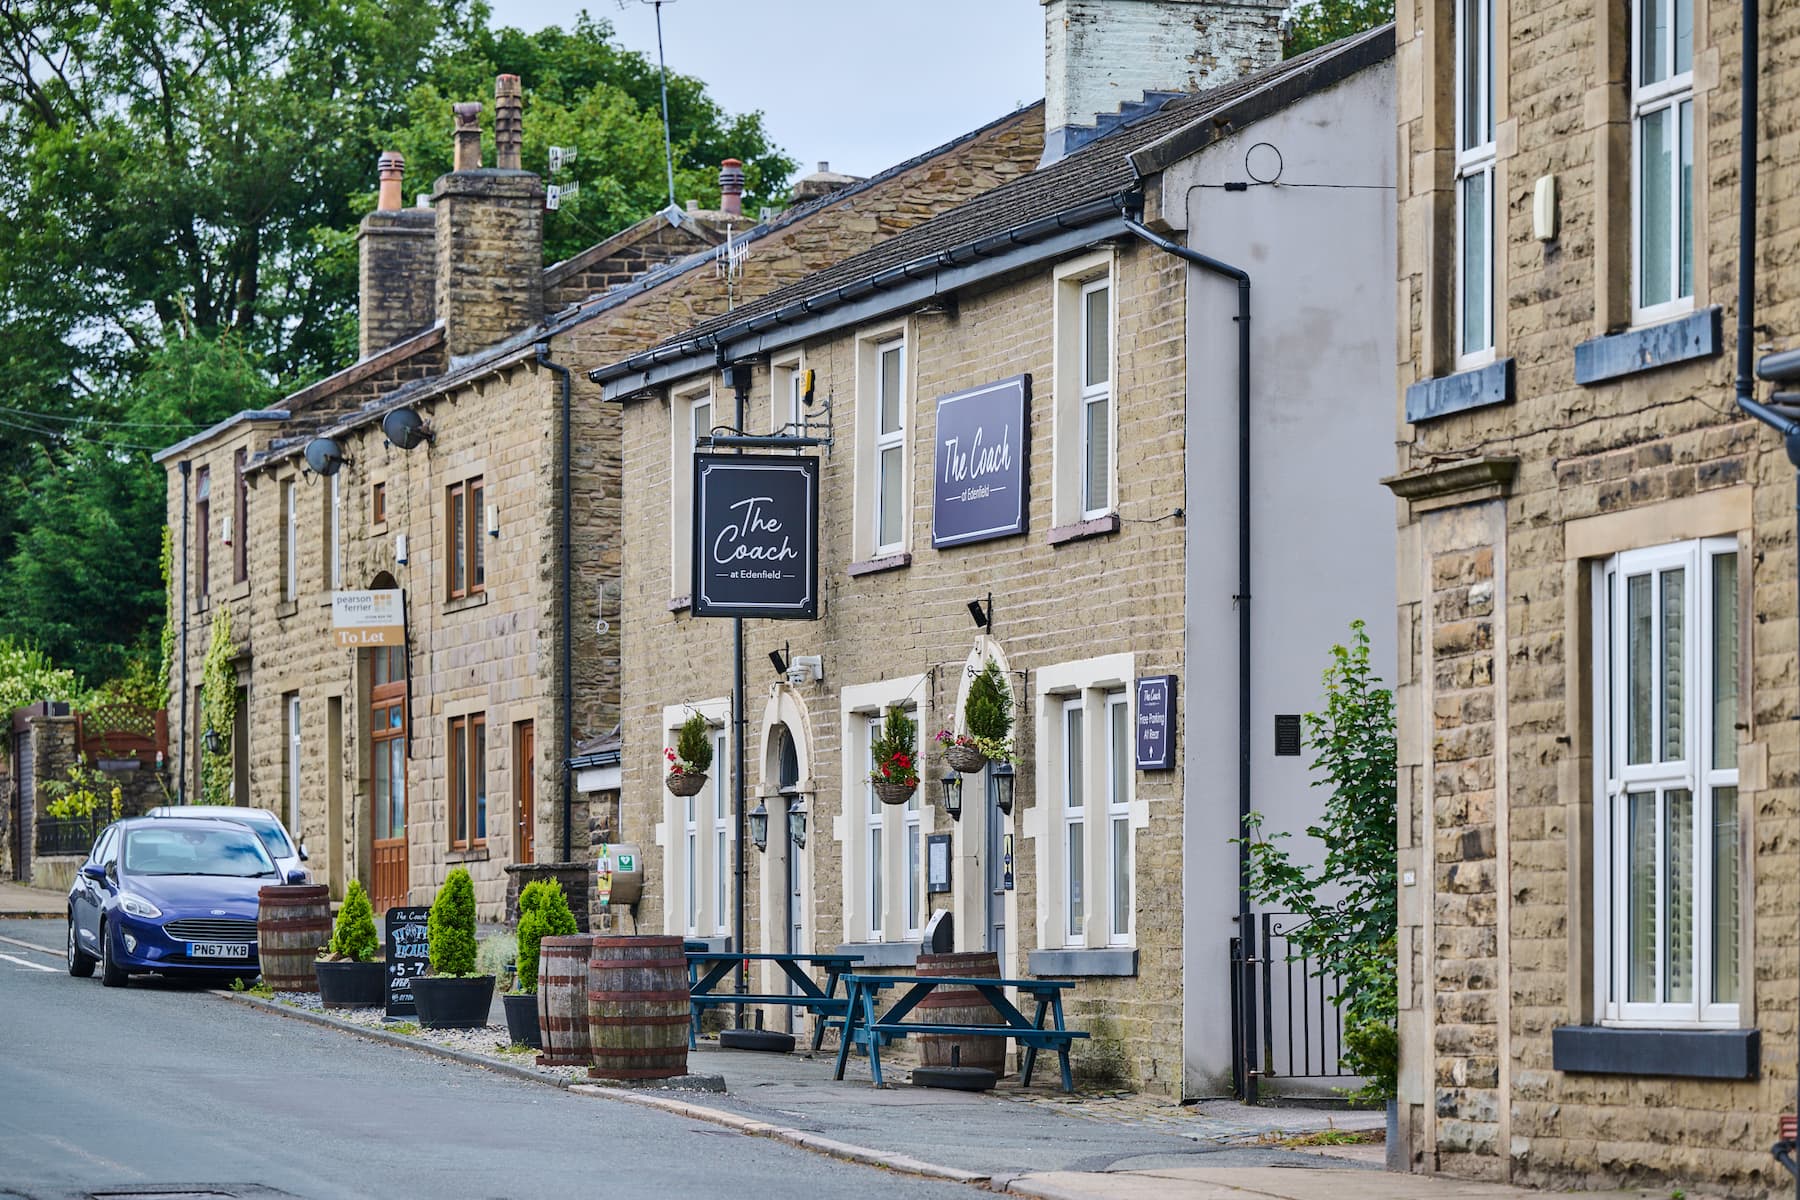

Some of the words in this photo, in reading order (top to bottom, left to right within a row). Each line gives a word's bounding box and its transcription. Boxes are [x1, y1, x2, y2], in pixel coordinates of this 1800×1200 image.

[945, 436, 967, 484] The
[970, 423, 1011, 479] Coach
[967, 484, 989, 501] Edenfield
[730, 497, 782, 537] The
[713, 524, 798, 564] Coach
[730, 570, 739, 579] at
[740, 570, 781, 579] Edenfield
[336, 596, 371, 605] pearson
[344, 604, 371, 612] ferrier
[338, 631, 358, 644] To
[361, 630, 385, 643] Let
[1139, 713, 1149, 725] Free
[1149, 712, 1165, 726] Parking
[1149, 728, 1160, 740] Rear
[194, 944, 223, 956] PN67
[225, 945, 247, 956] YKB
